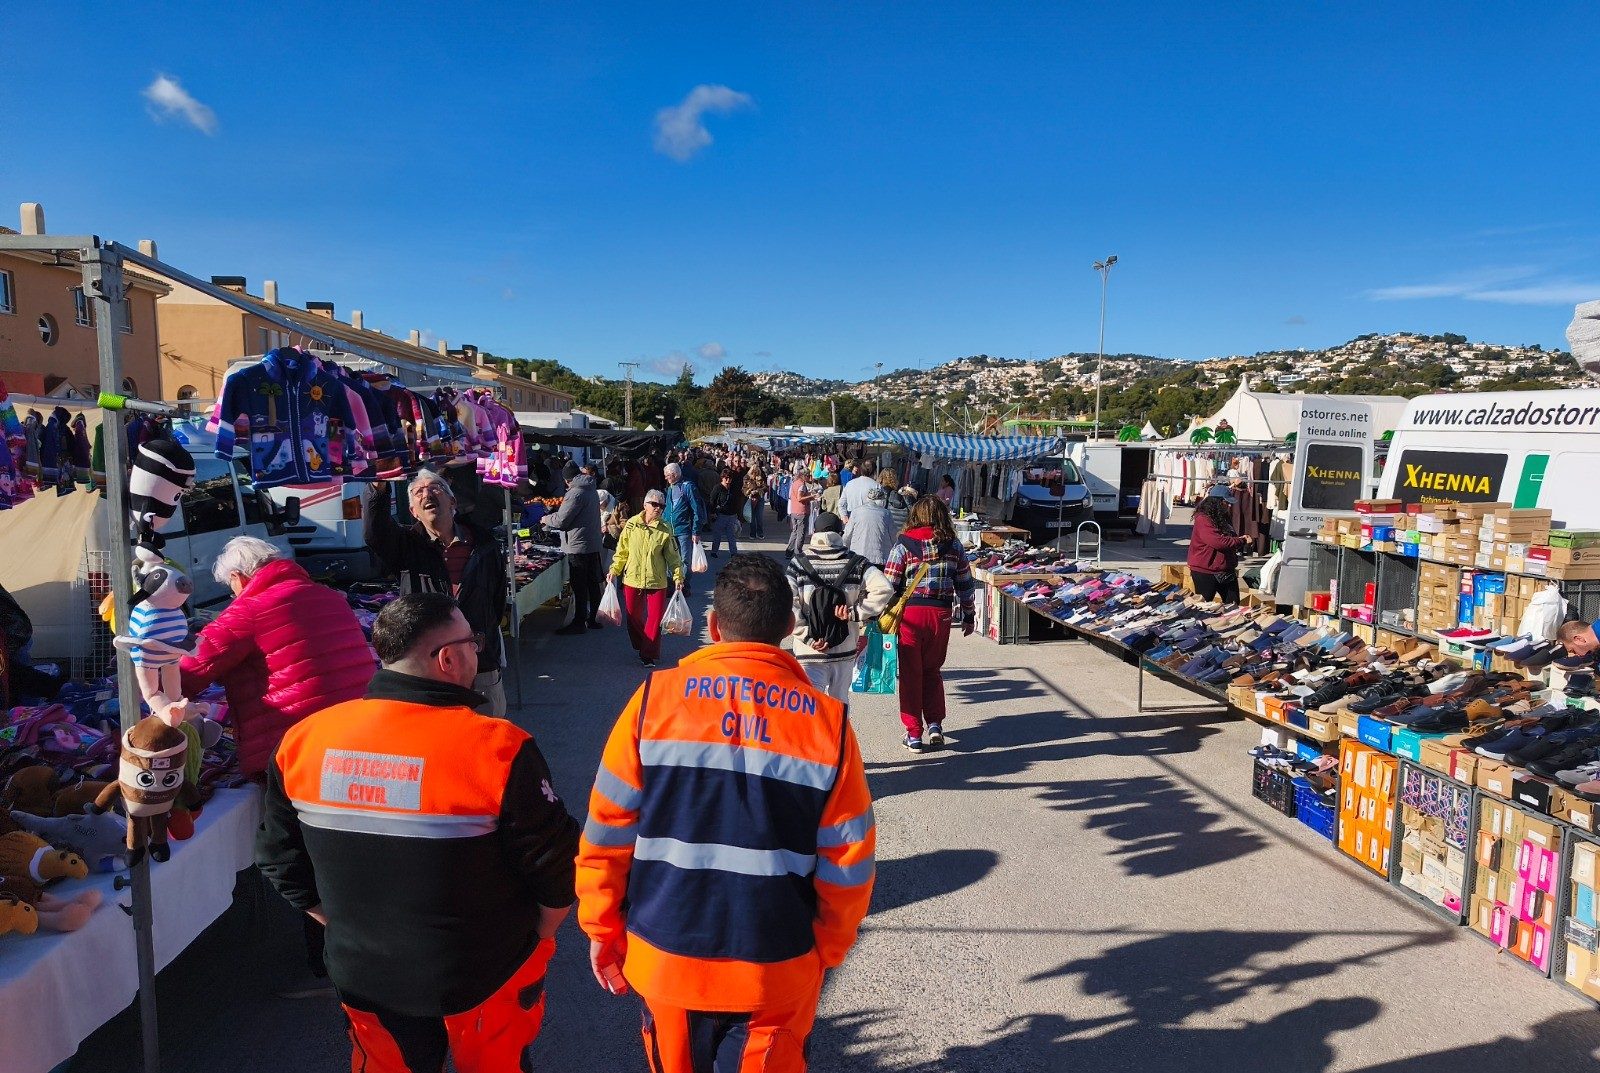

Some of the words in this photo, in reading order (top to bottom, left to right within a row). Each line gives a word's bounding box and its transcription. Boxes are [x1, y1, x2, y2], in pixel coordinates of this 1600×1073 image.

[1301, 409, 1368, 422] ostorres.net
[1307, 426, 1336, 437] tienda
[1339, 428, 1367, 439] online
[1307, 465, 1360, 480] XHENNA
[1403, 463, 1490, 494] XHENNA
[684, 675, 816, 715] PROTECCIÓN
[721, 711, 771, 743] CIVIL
[348, 783, 386, 804] CIVIL
